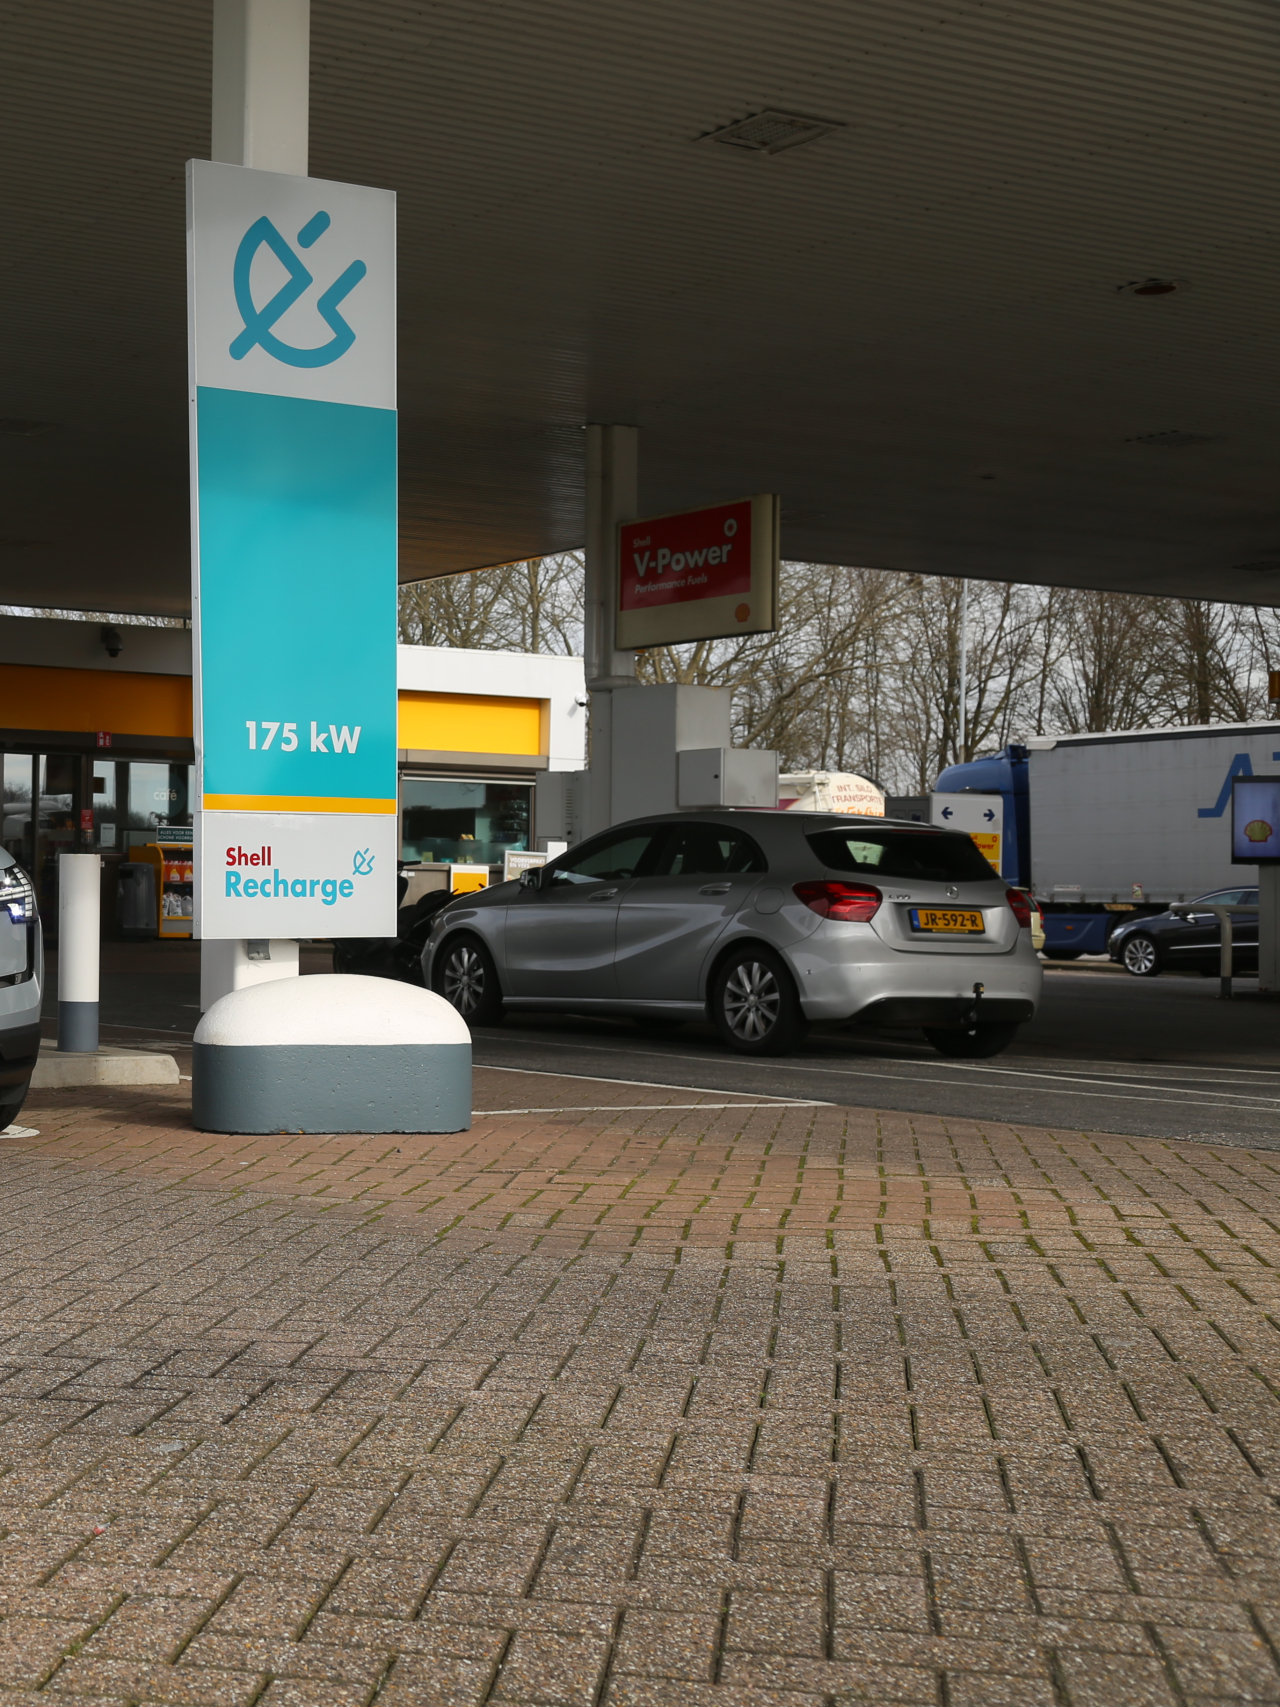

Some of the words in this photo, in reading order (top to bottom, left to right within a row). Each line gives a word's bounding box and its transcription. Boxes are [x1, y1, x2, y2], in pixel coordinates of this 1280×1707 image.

[633, 535, 651, 549] Shell
[632, 543, 732, 578] V-Power
[634, 577, 686, 594] Performance
[687, 572, 708, 586] Fuels
[245, 720, 299, 752] 175
[310, 721, 362, 754] kW
[153, 788, 178, 801] café
[836, 784, 854, 792] INT.
[225, 845, 272, 866] Shell
[225, 868, 354, 906] Recharge
[923, 912, 979, 928] JR-592-R
